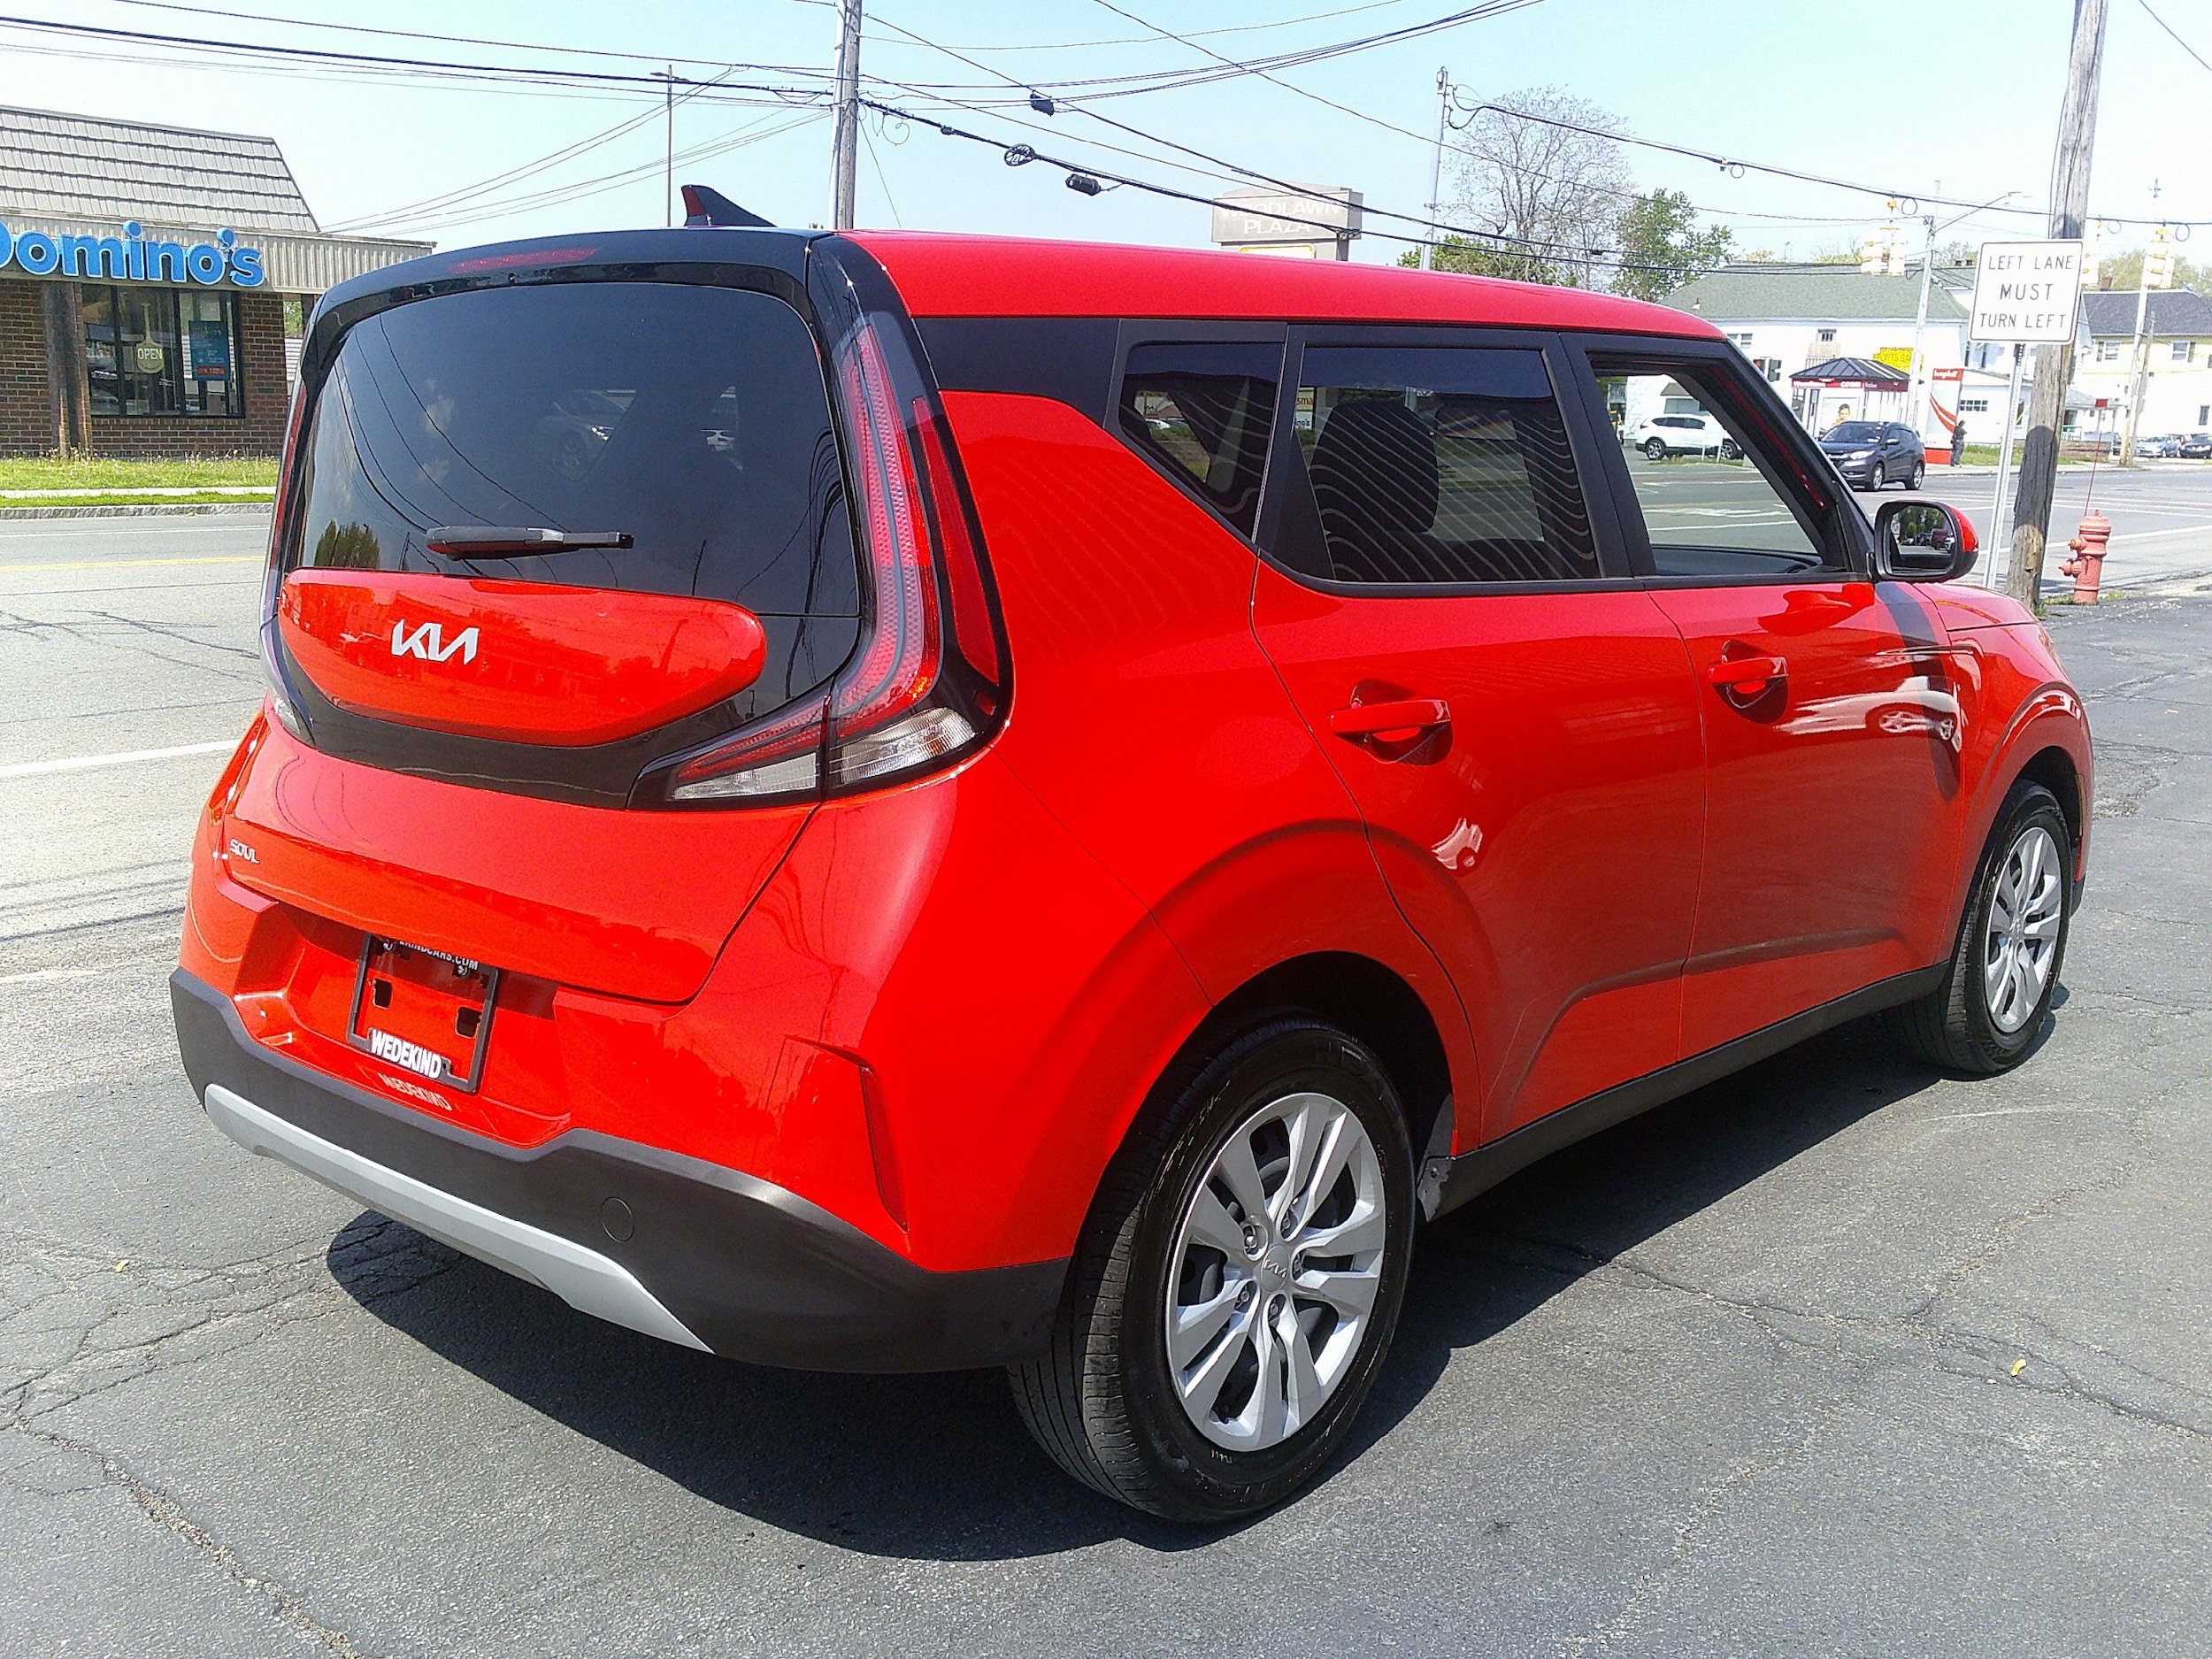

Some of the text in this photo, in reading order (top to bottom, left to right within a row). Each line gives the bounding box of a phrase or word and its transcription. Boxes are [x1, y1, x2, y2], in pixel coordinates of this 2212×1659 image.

[1243, 219, 1311, 234] PLAZA
[0, 219, 265, 287] omino's
[1988, 255, 2074, 270] LEFT LANE
[2000, 283, 2054, 300] MUST
[1980, 313, 2067, 328] TURN LEFT
[137, 348, 164, 359] OPEN
[391, 619, 480, 665] KIA
[229, 838, 260, 864] SOUL
[372, 1029, 442, 1079] WEDEKIND
